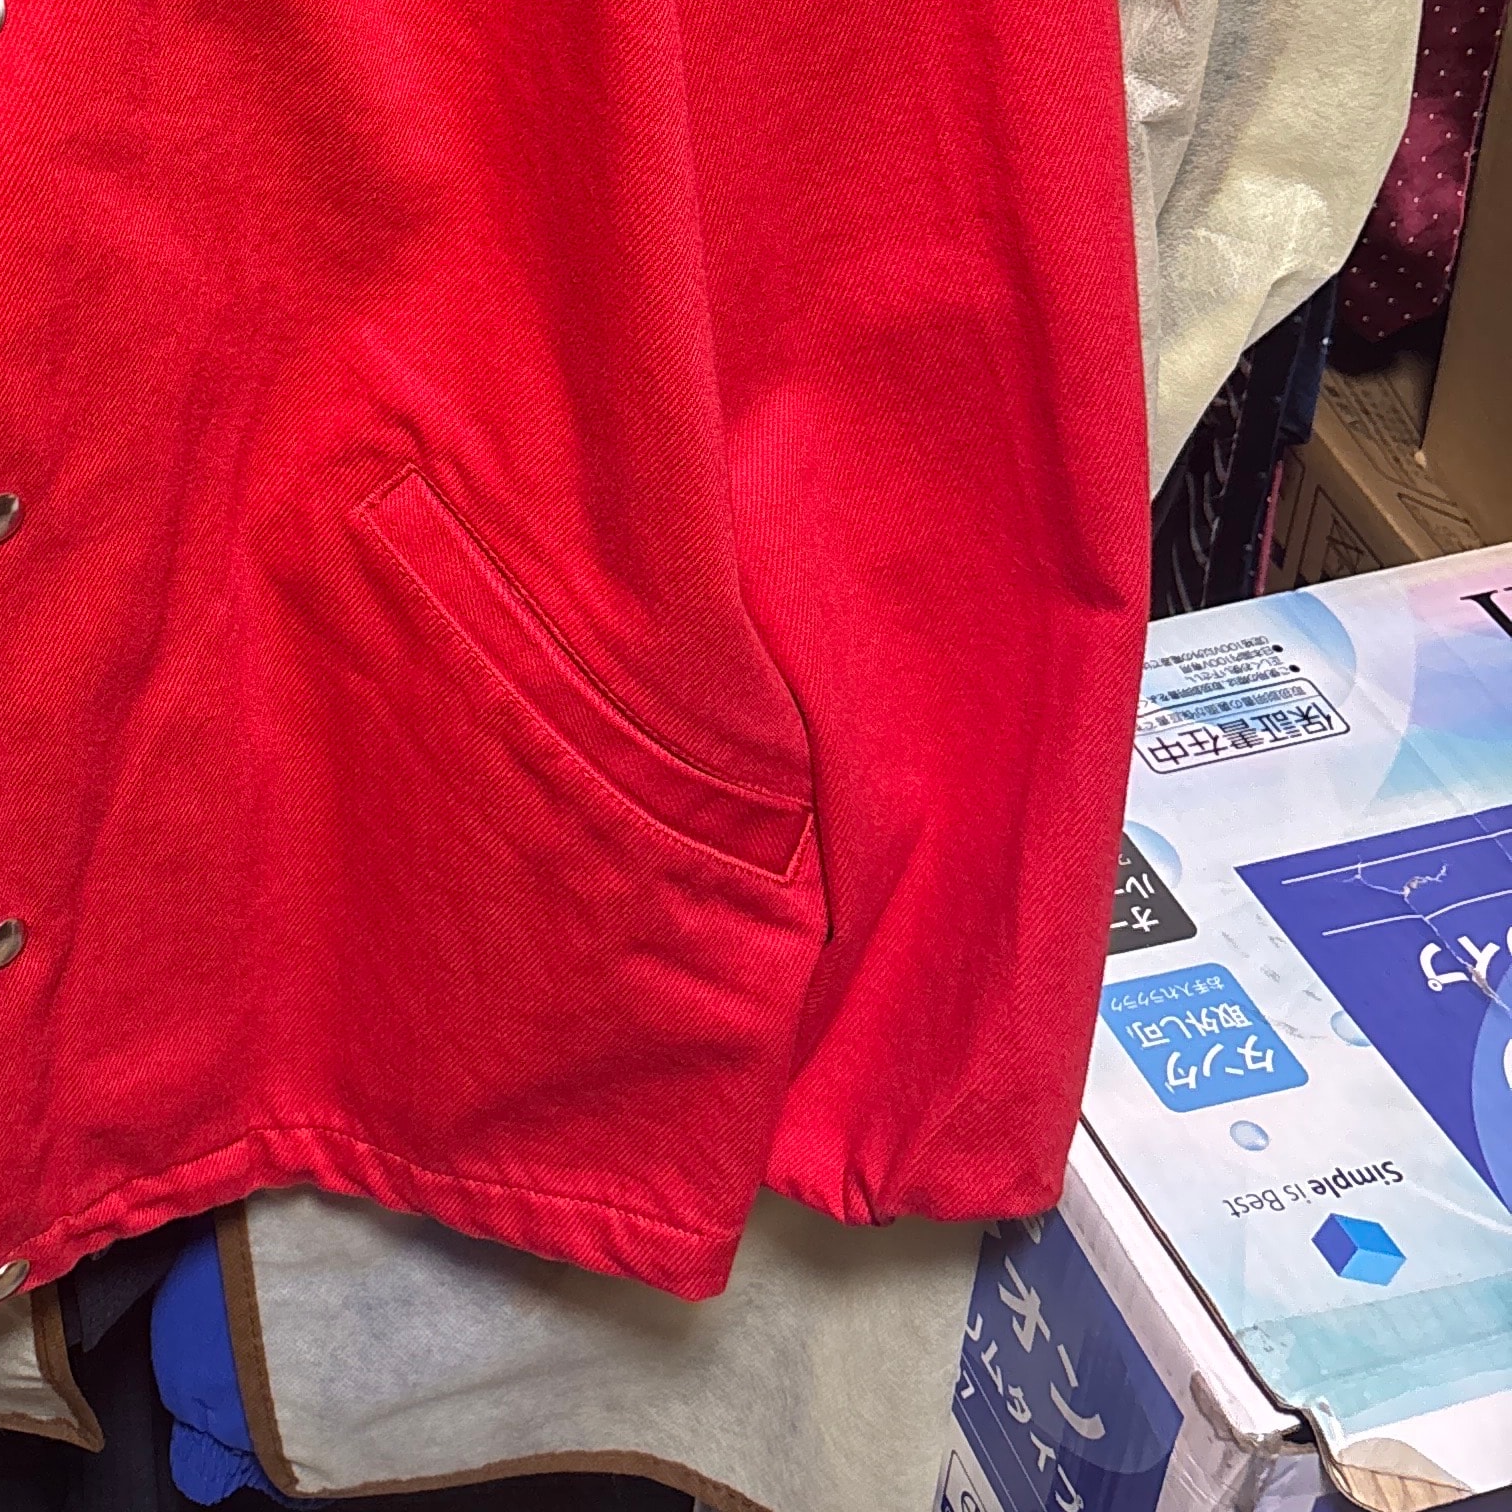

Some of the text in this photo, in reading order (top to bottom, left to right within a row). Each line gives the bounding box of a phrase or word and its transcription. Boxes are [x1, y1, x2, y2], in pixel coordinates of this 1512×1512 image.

[1148, 701, 1334, 765] 保証書在中
[1420, 926, 1512, 992] イプ
[1110, 975, 1225, 1012] お手入れラクラク
[1129, 1002, 1253, 1050] 取外し可
[1166, 1034, 1274, 1090] タンク
[1222, 1160, 1404, 1218] Simple is Best
[985, 1221, 1106, 1440] オン
